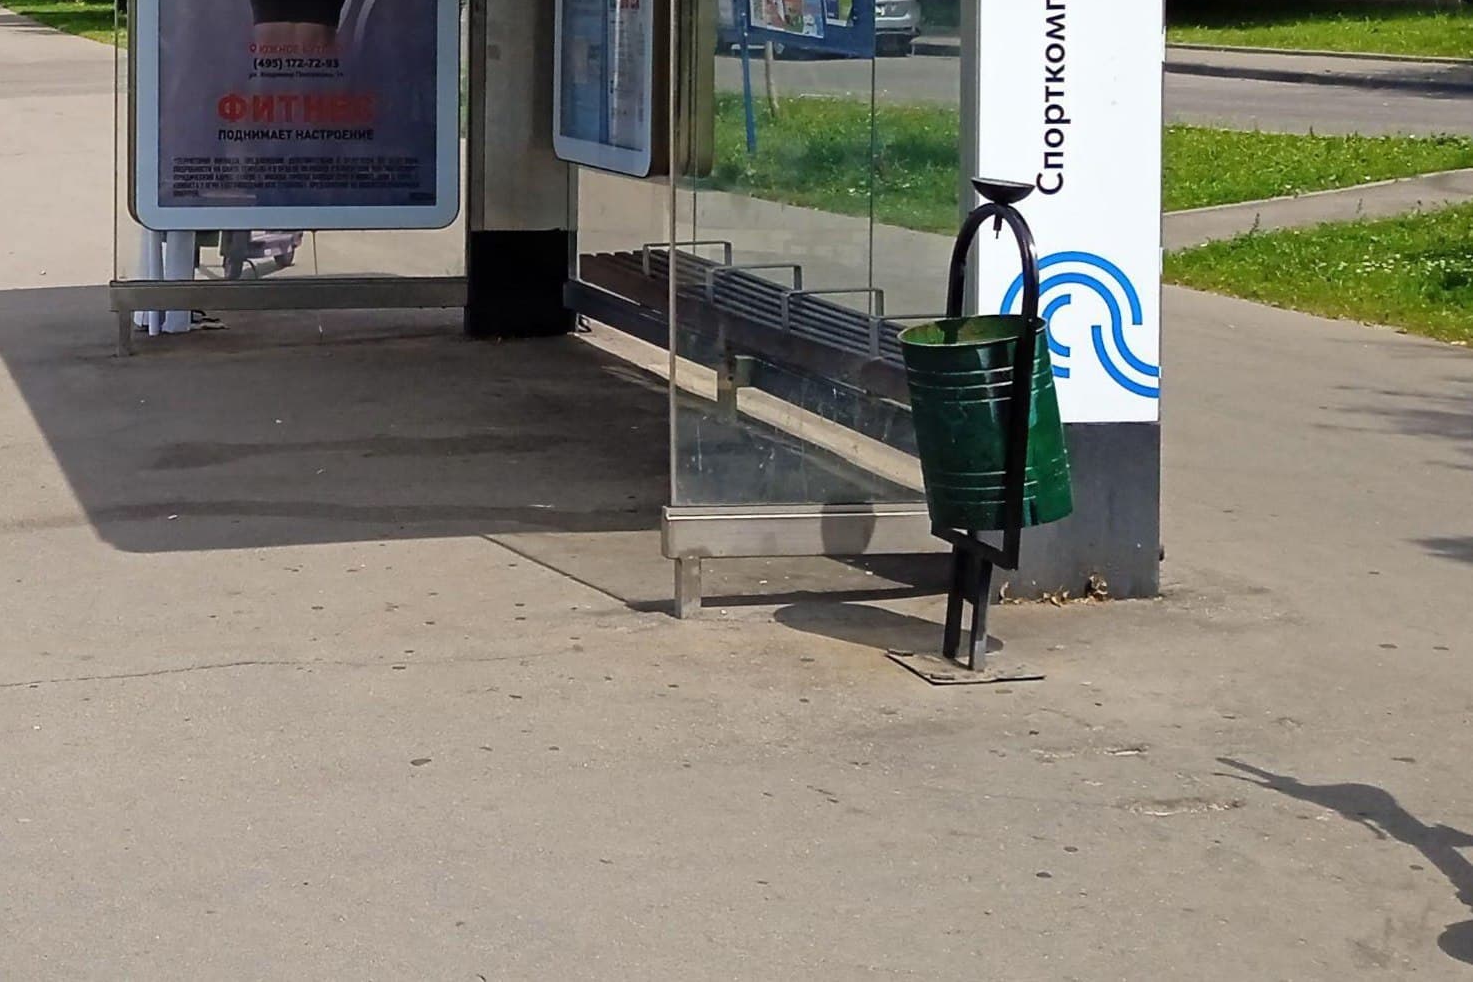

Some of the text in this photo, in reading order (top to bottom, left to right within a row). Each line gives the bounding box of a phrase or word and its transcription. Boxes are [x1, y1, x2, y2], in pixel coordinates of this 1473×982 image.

[253, 58, 283, 70] (495)
[217, 92, 376, 122] ФИТНЕС
[218, 129, 375, 142] ПОДНИМАЕТ НАСТРОЕНИЕ
